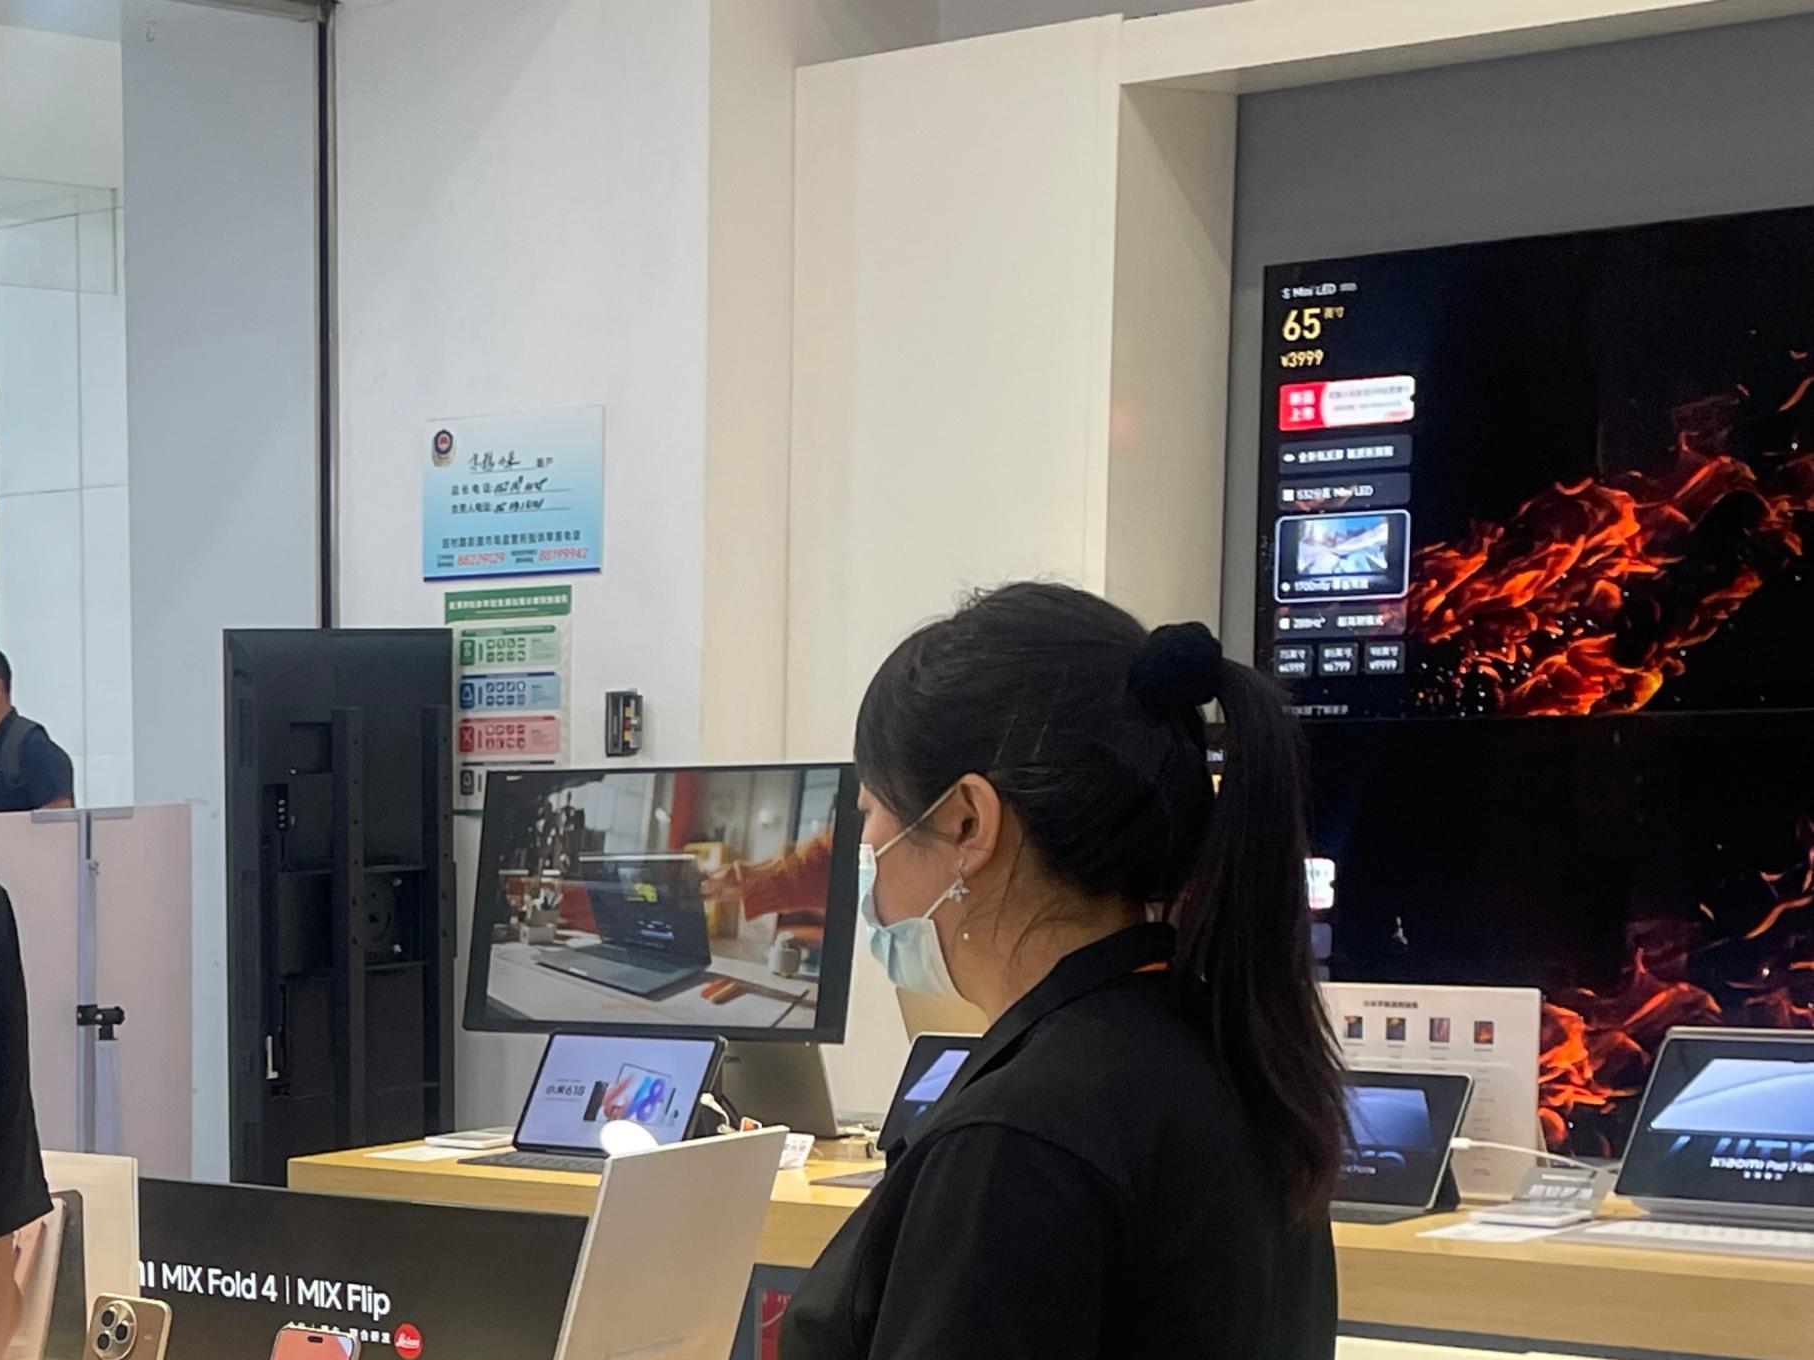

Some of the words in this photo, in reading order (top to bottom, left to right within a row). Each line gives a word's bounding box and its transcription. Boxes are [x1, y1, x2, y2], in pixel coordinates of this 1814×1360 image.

[1282, 307, 1322, 341] 65
[162, 1263, 203, 1293] MIX
[207, 1268, 257, 1300] Fold
[261, 1275, 278, 1302] 4
[297, 1278, 342, 1310] MIX
[347, 1283, 391, 1321] Flip
